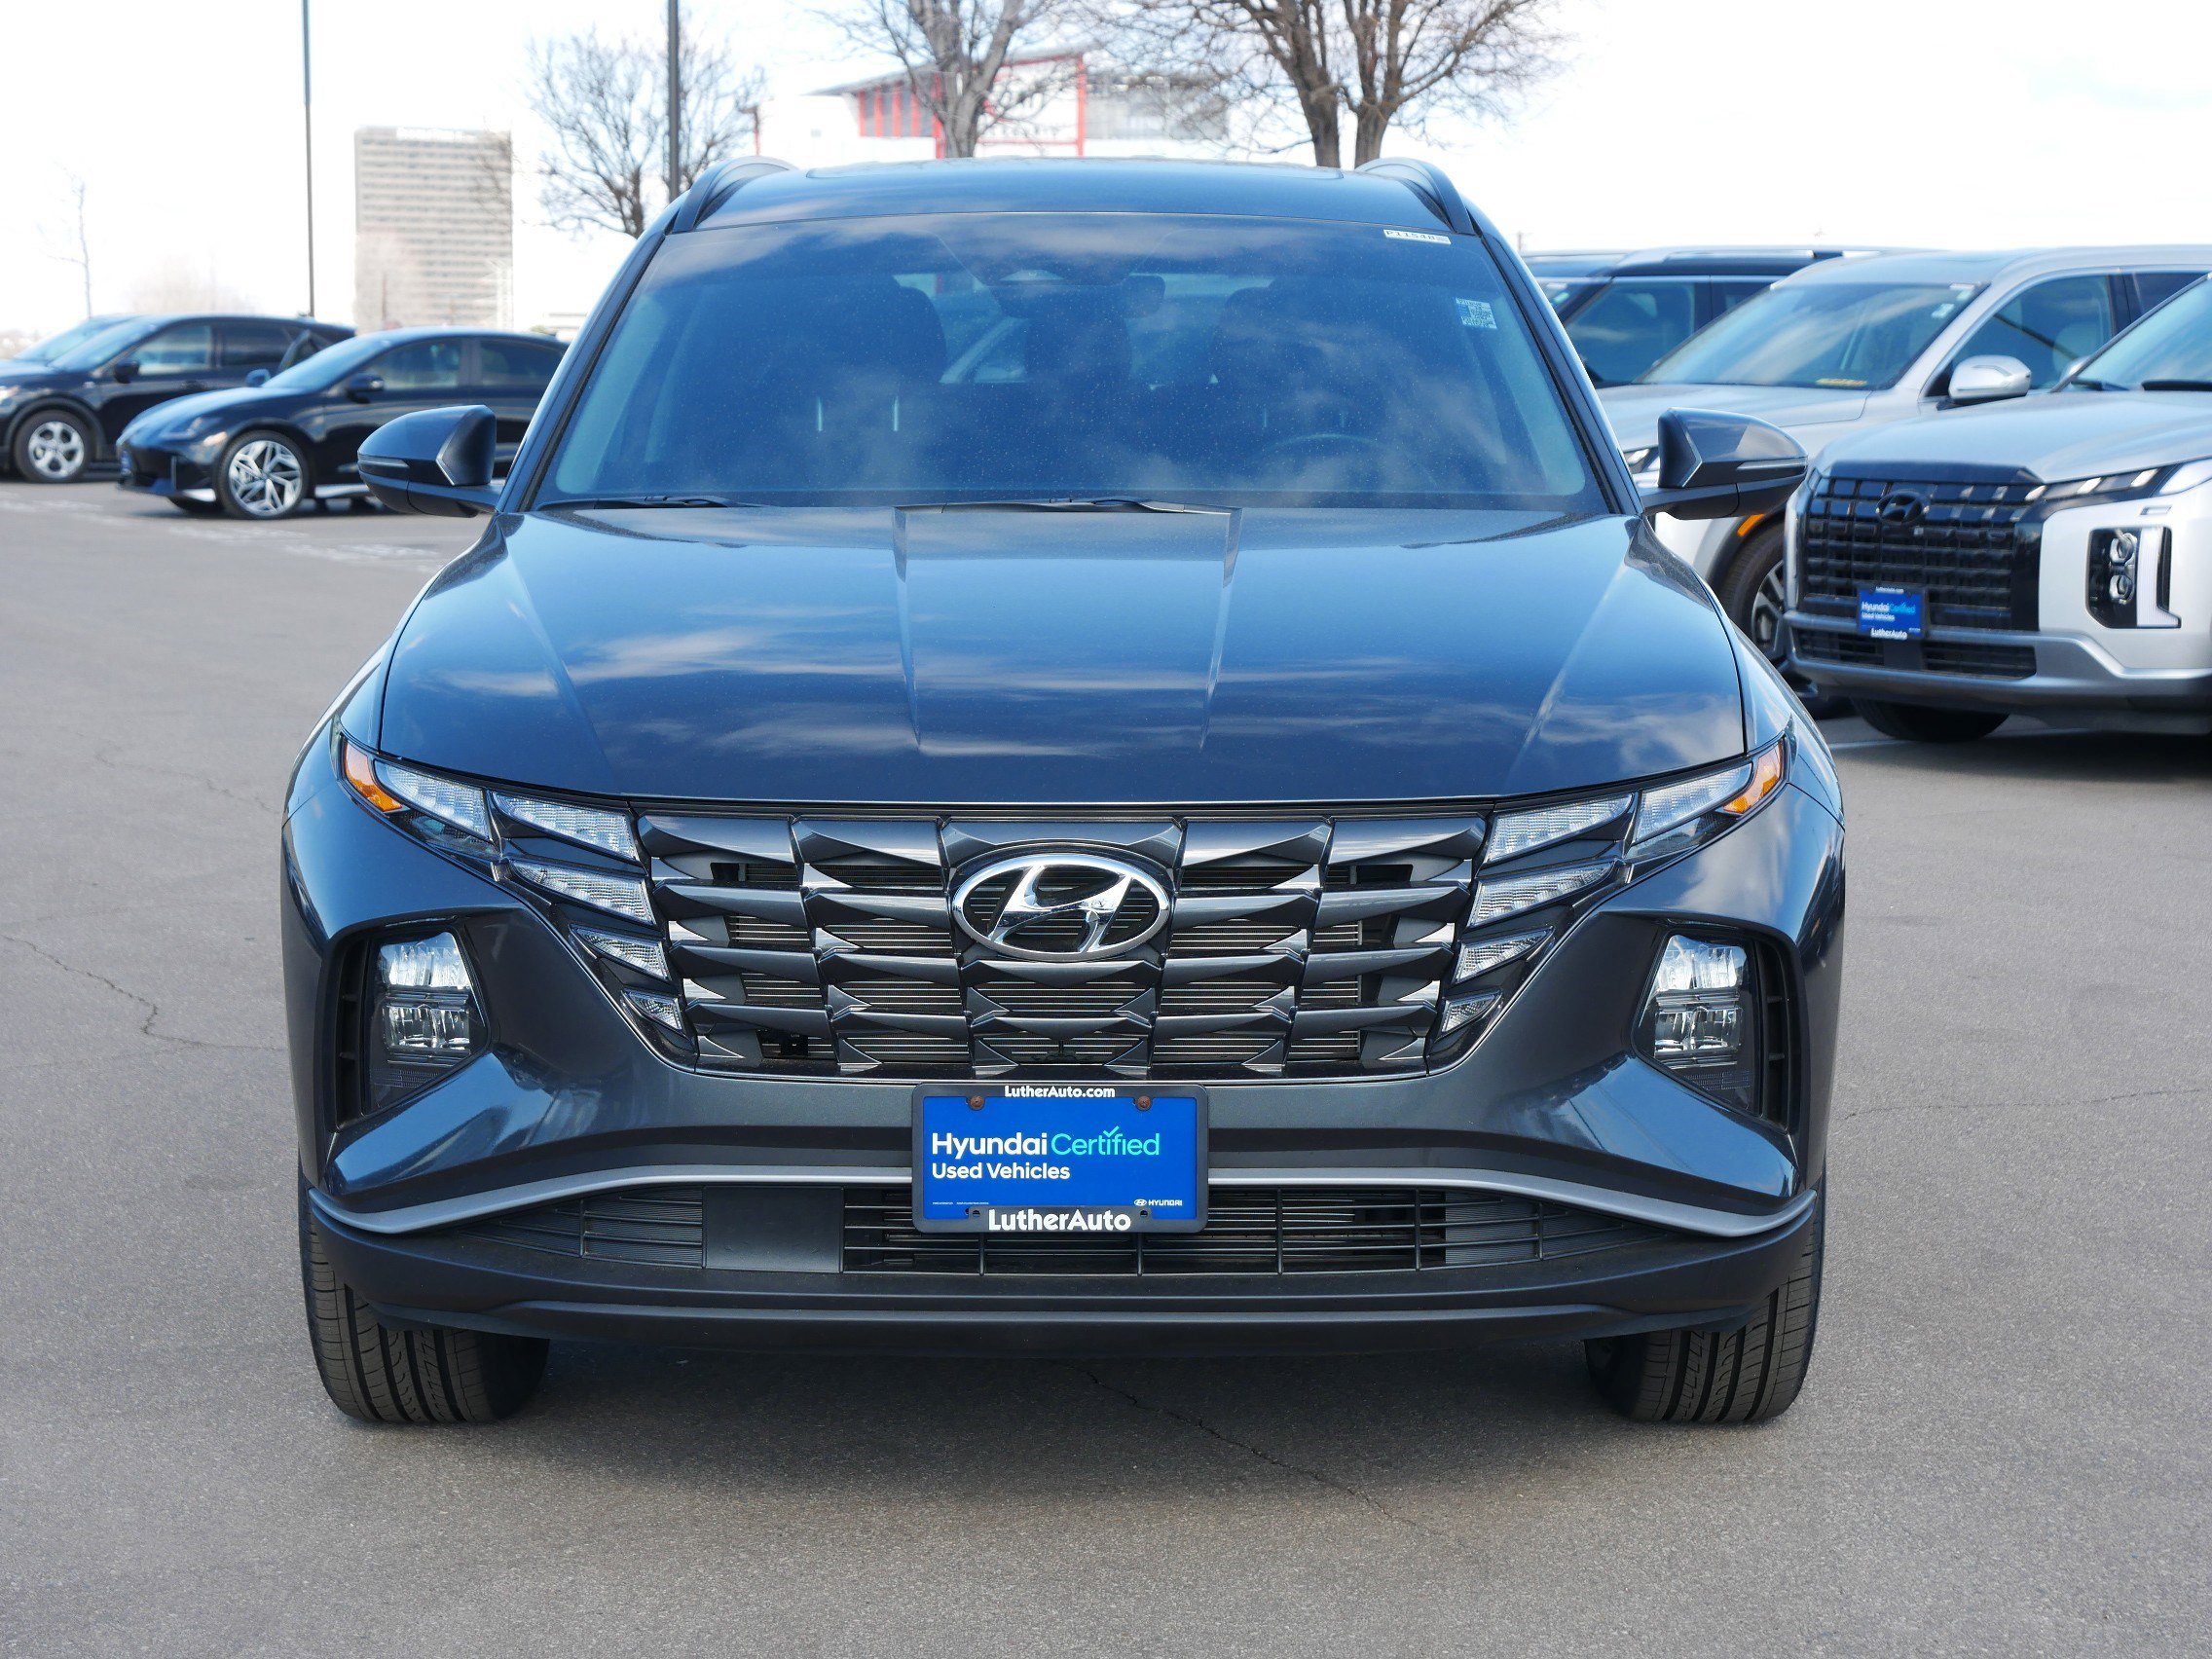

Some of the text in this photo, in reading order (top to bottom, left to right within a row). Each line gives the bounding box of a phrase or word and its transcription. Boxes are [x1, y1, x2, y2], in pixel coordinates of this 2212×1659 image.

[1871, 627, 1907, 641] LutherAuto
[1004, 1085, 1116, 1098] LutherAuto.com
[932, 1126, 1160, 1160] Hyundai Certified
[932, 1162, 1071, 1180] Used Vehicles
[988, 1209, 1132, 1231] LutherAuto
